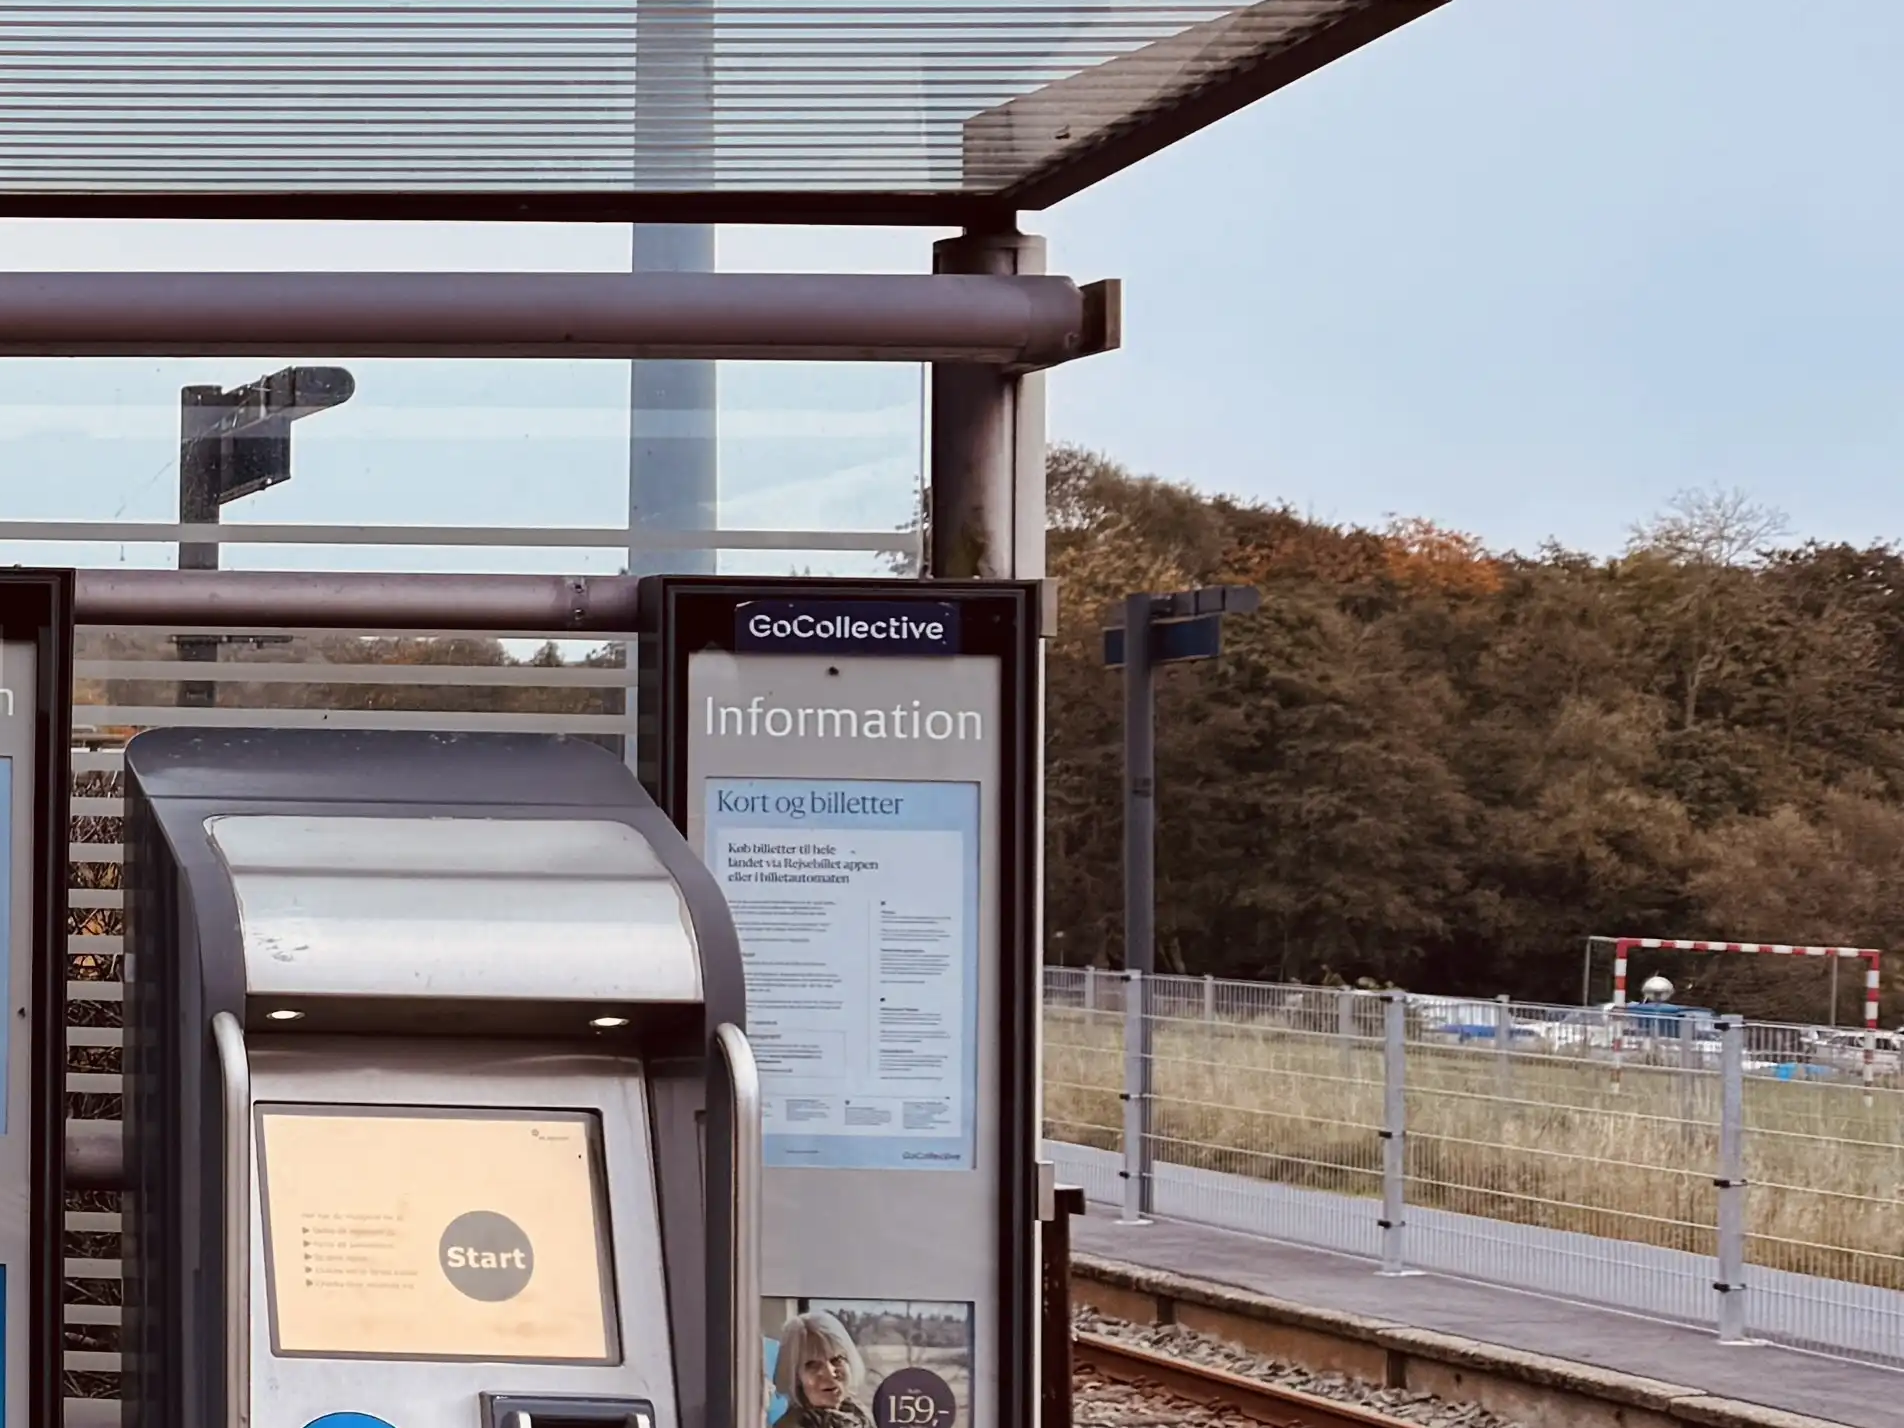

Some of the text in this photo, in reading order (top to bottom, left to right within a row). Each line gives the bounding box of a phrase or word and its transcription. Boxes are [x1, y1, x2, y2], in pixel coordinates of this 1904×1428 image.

[748, 614, 944, 642] GoCollective
[705, 696, 983, 741] Information
[717, 789, 904, 820] Kort og billetter
[753, 843, 796, 854] billetter
[799, 843, 810, 855] til
[728, 857, 879, 871] landet via appen
[728, 872, 752, 883] eller
[760, 873, 850, 883] billetautomaten
[447, 1245, 526, 1270] Start
[888, 1396, 950, 1427] 159,-
